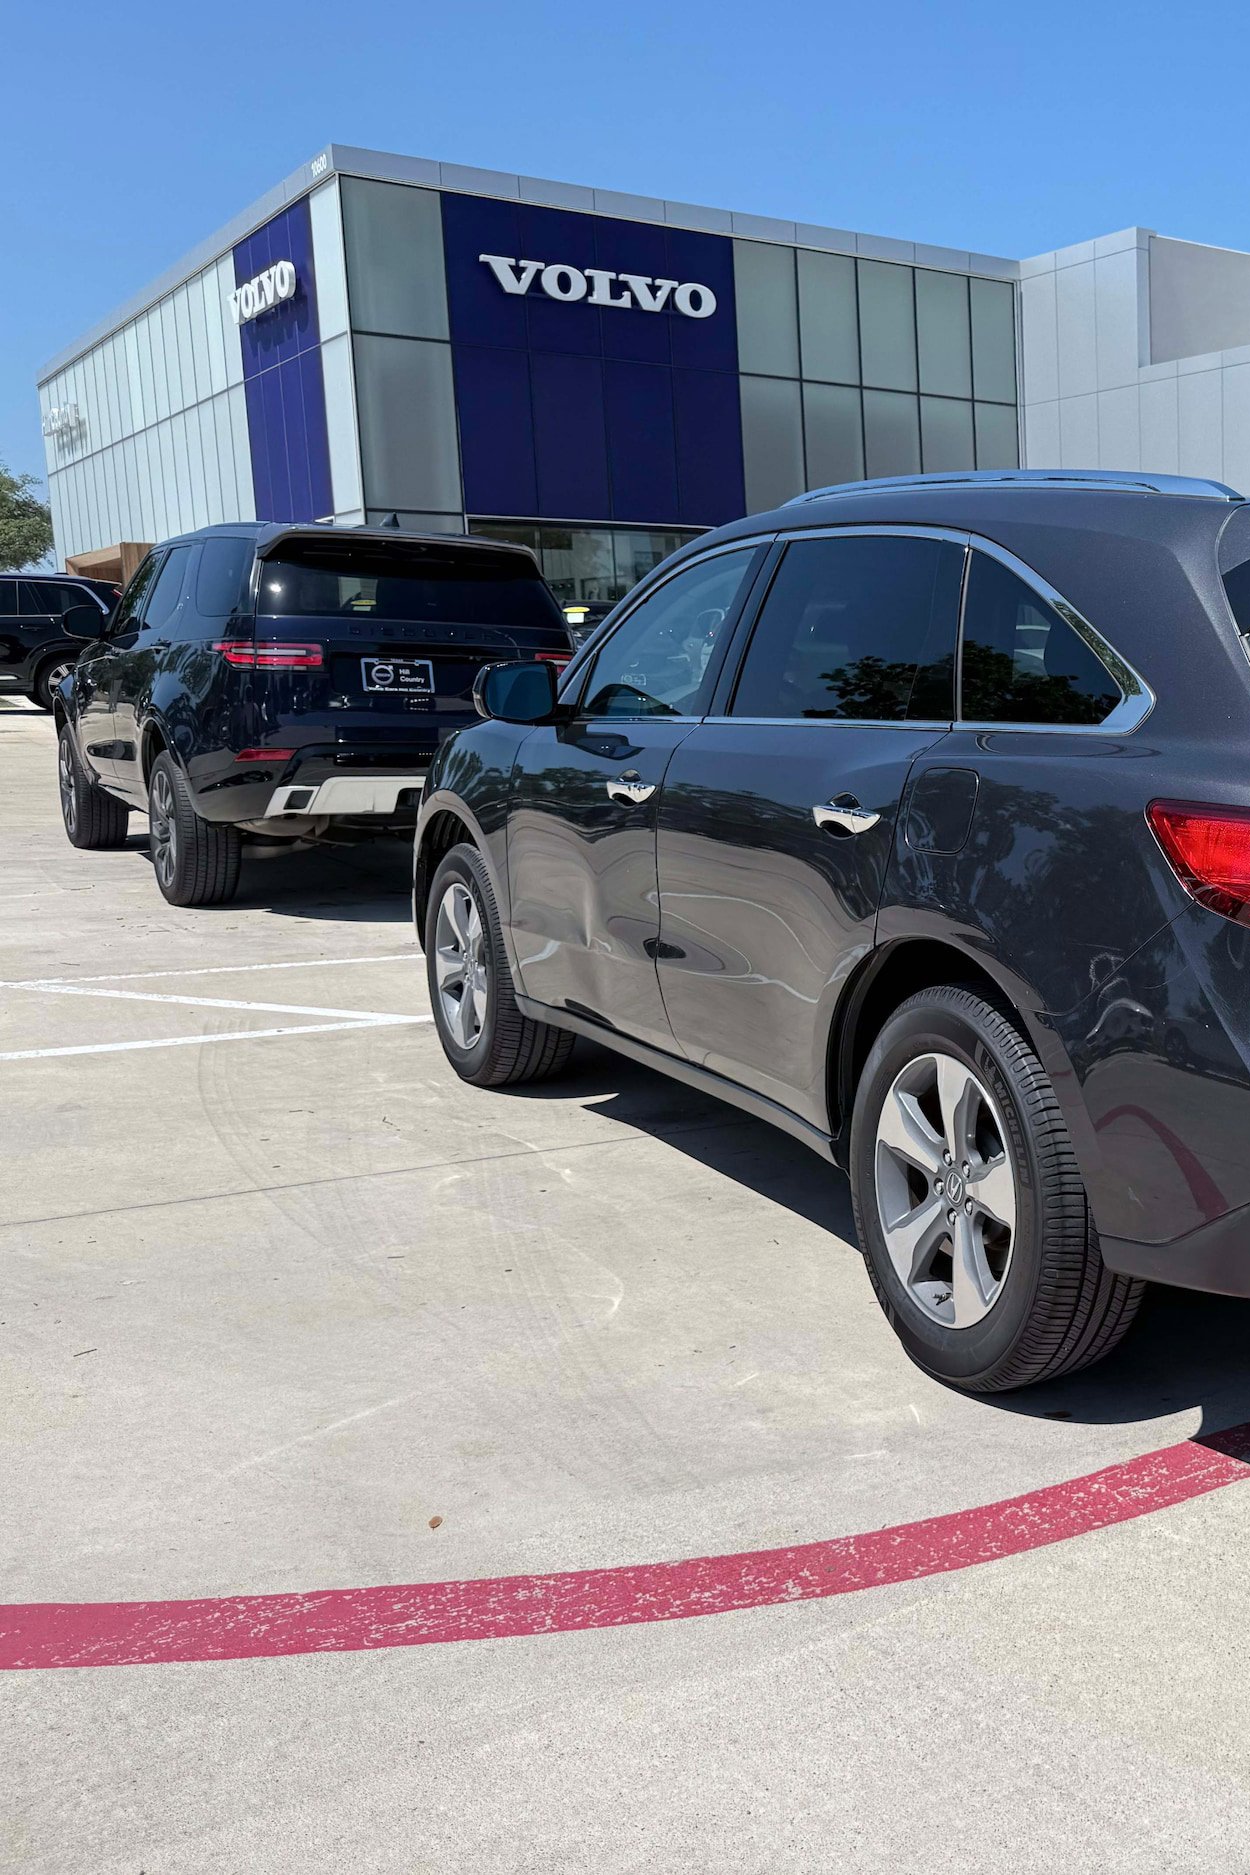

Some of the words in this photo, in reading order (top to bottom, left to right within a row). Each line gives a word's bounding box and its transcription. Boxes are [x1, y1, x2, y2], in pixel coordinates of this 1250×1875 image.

[227, 260, 296, 326] VOLVO
[479, 253, 718, 319] VOLVO
[400, 675, 425, 684] Country
[995, 1083, 1029, 1186] MICHELIN
